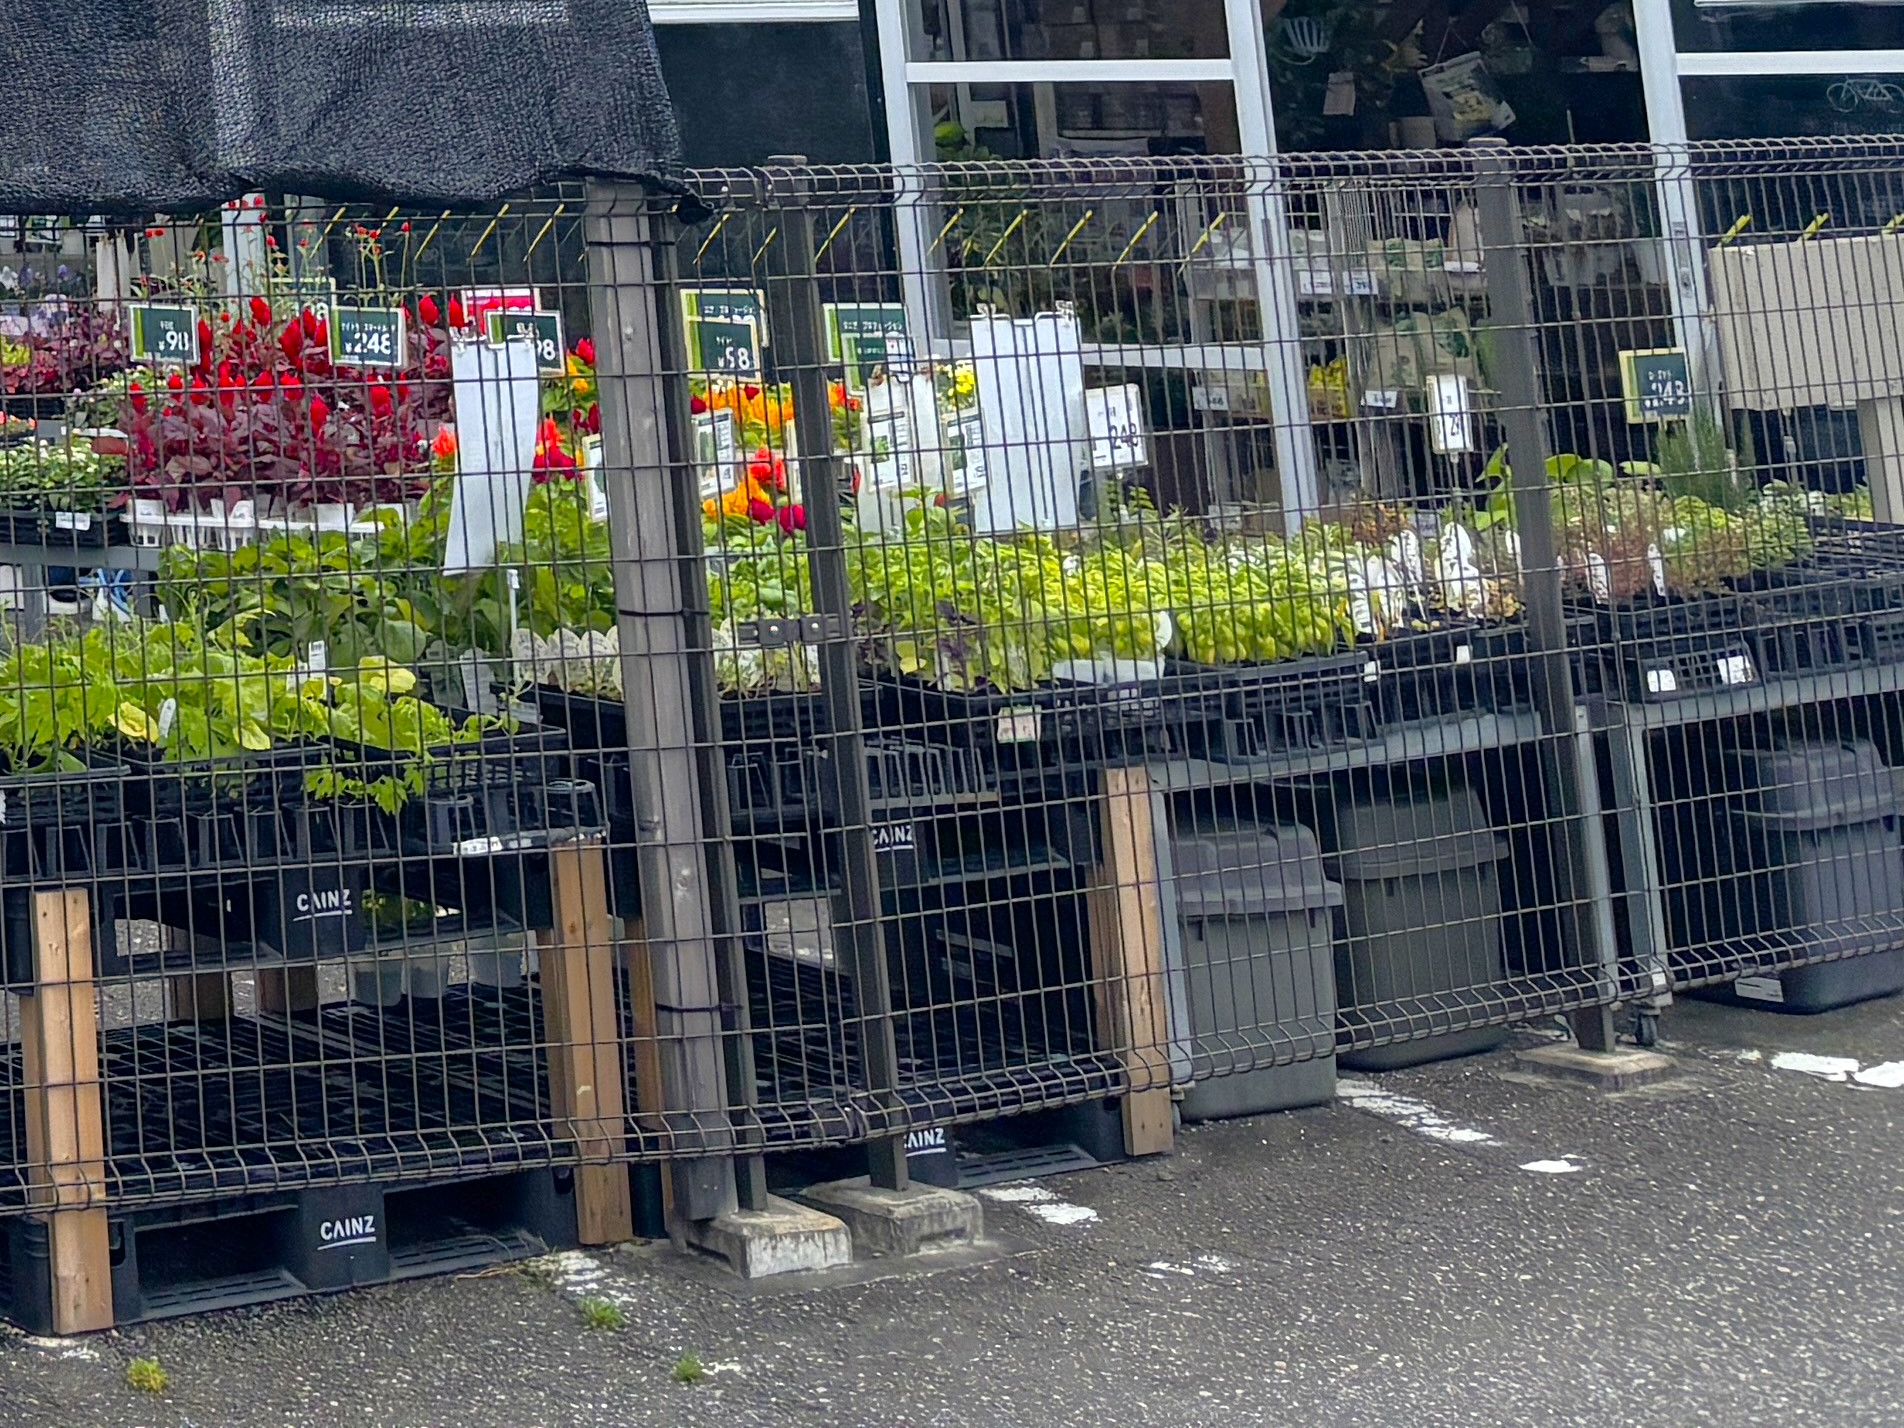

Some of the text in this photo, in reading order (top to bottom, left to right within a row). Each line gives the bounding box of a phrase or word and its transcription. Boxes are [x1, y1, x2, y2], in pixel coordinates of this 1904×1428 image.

[872, 825, 912, 845] ANZ
[296, 889, 352, 911] CAINZ
[320, 1215, 376, 1241] CAINZ
